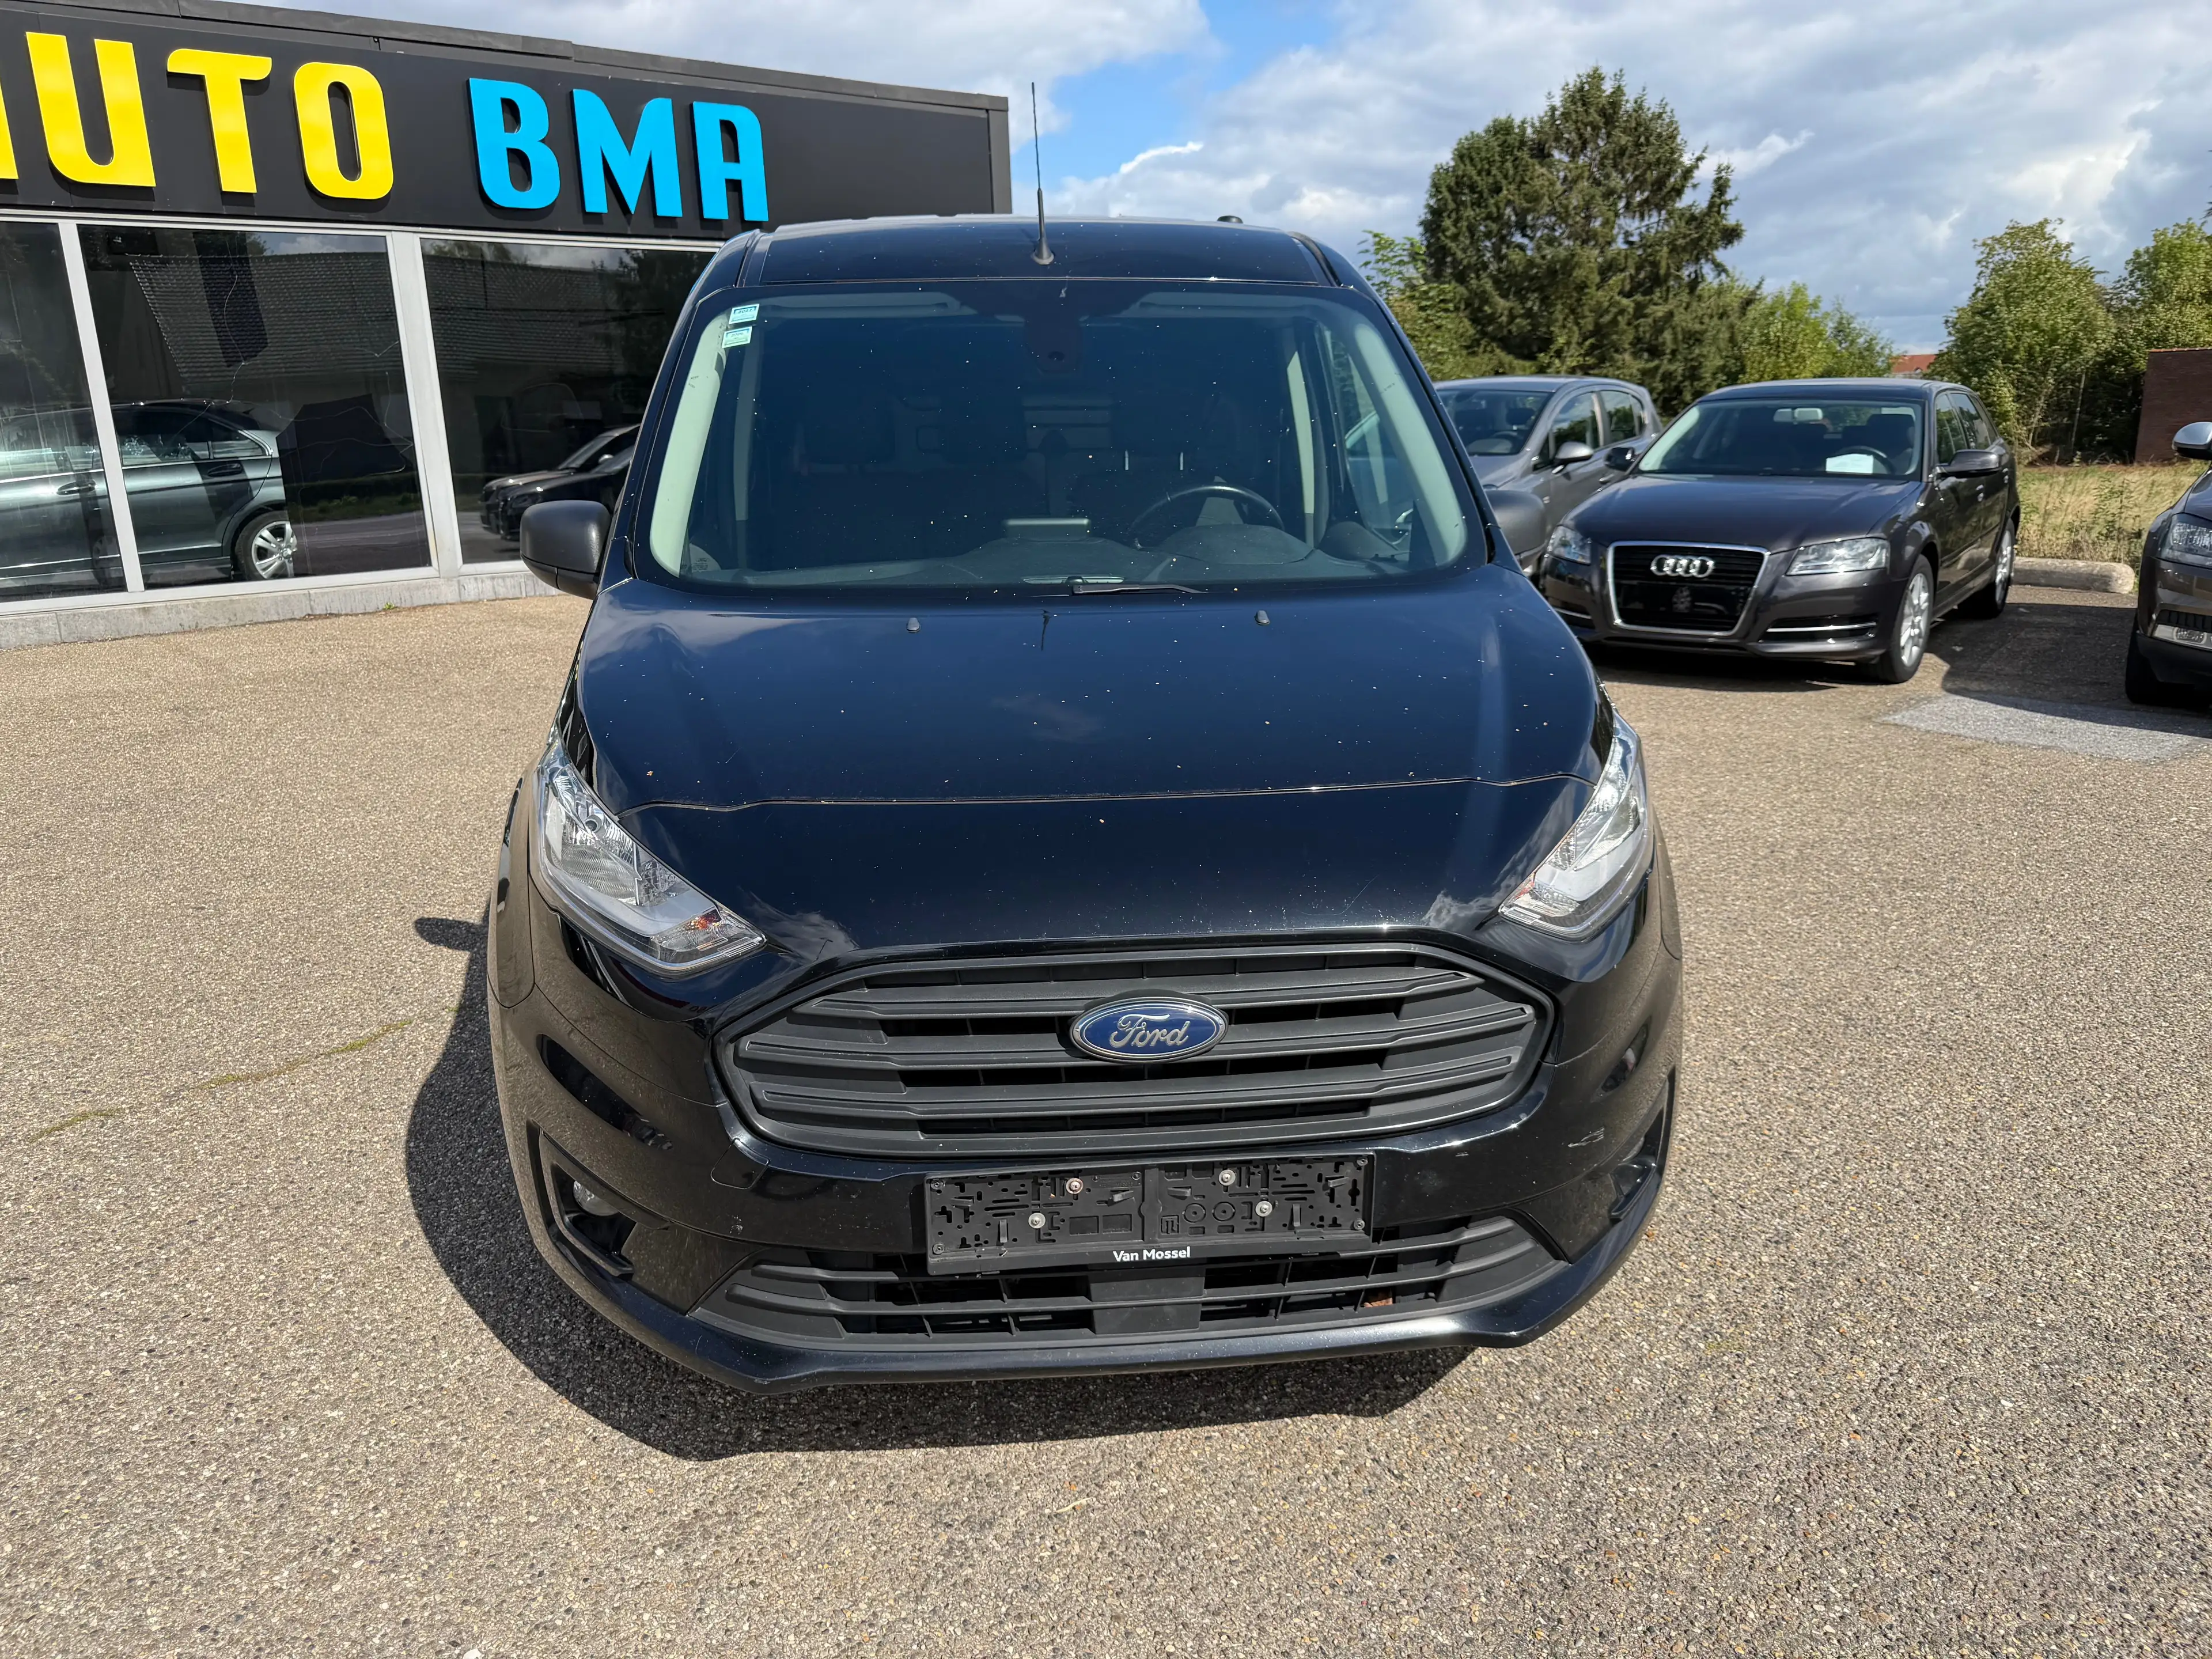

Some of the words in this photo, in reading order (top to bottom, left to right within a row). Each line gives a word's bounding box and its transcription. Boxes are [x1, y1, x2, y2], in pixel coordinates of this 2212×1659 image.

[0, 32, 394, 200] UTO
[468, 78, 769, 222] BMA
[1109, 1013, 1191, 1048] Ford
[1112, 1251, 1139, 1262] Van
[1143, 1246, 1191, 1260] Mossel
